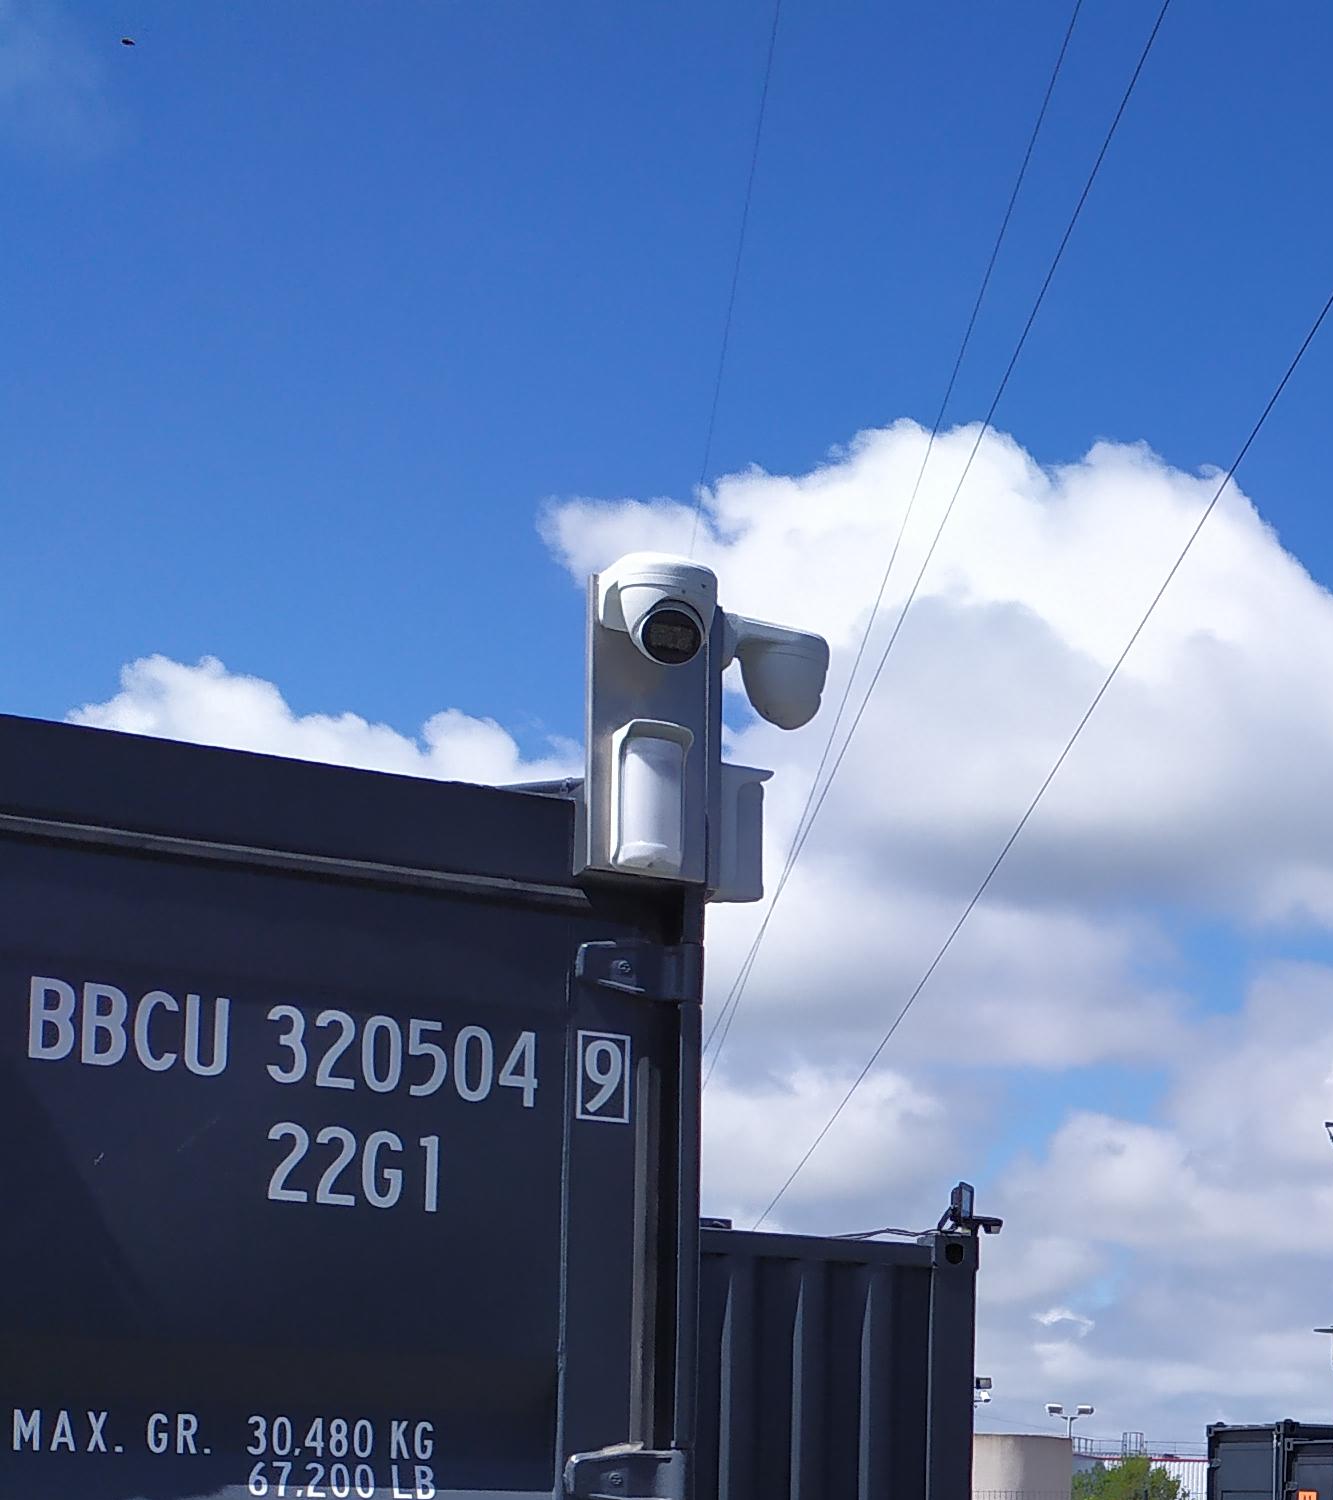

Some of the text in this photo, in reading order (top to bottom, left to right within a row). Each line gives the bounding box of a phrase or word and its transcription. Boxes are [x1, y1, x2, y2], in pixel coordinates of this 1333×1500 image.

[27, 975, 624, 1114] BBCU 320504 9
[267, 1121, 440, 1213] 22G1
[12, 1408, 124, 1454] MAX.
[146, 1413, 212, 1455] GR.
[390, 1420, 435, 1460] KG
[391, 1465, 436, 1500] LB
